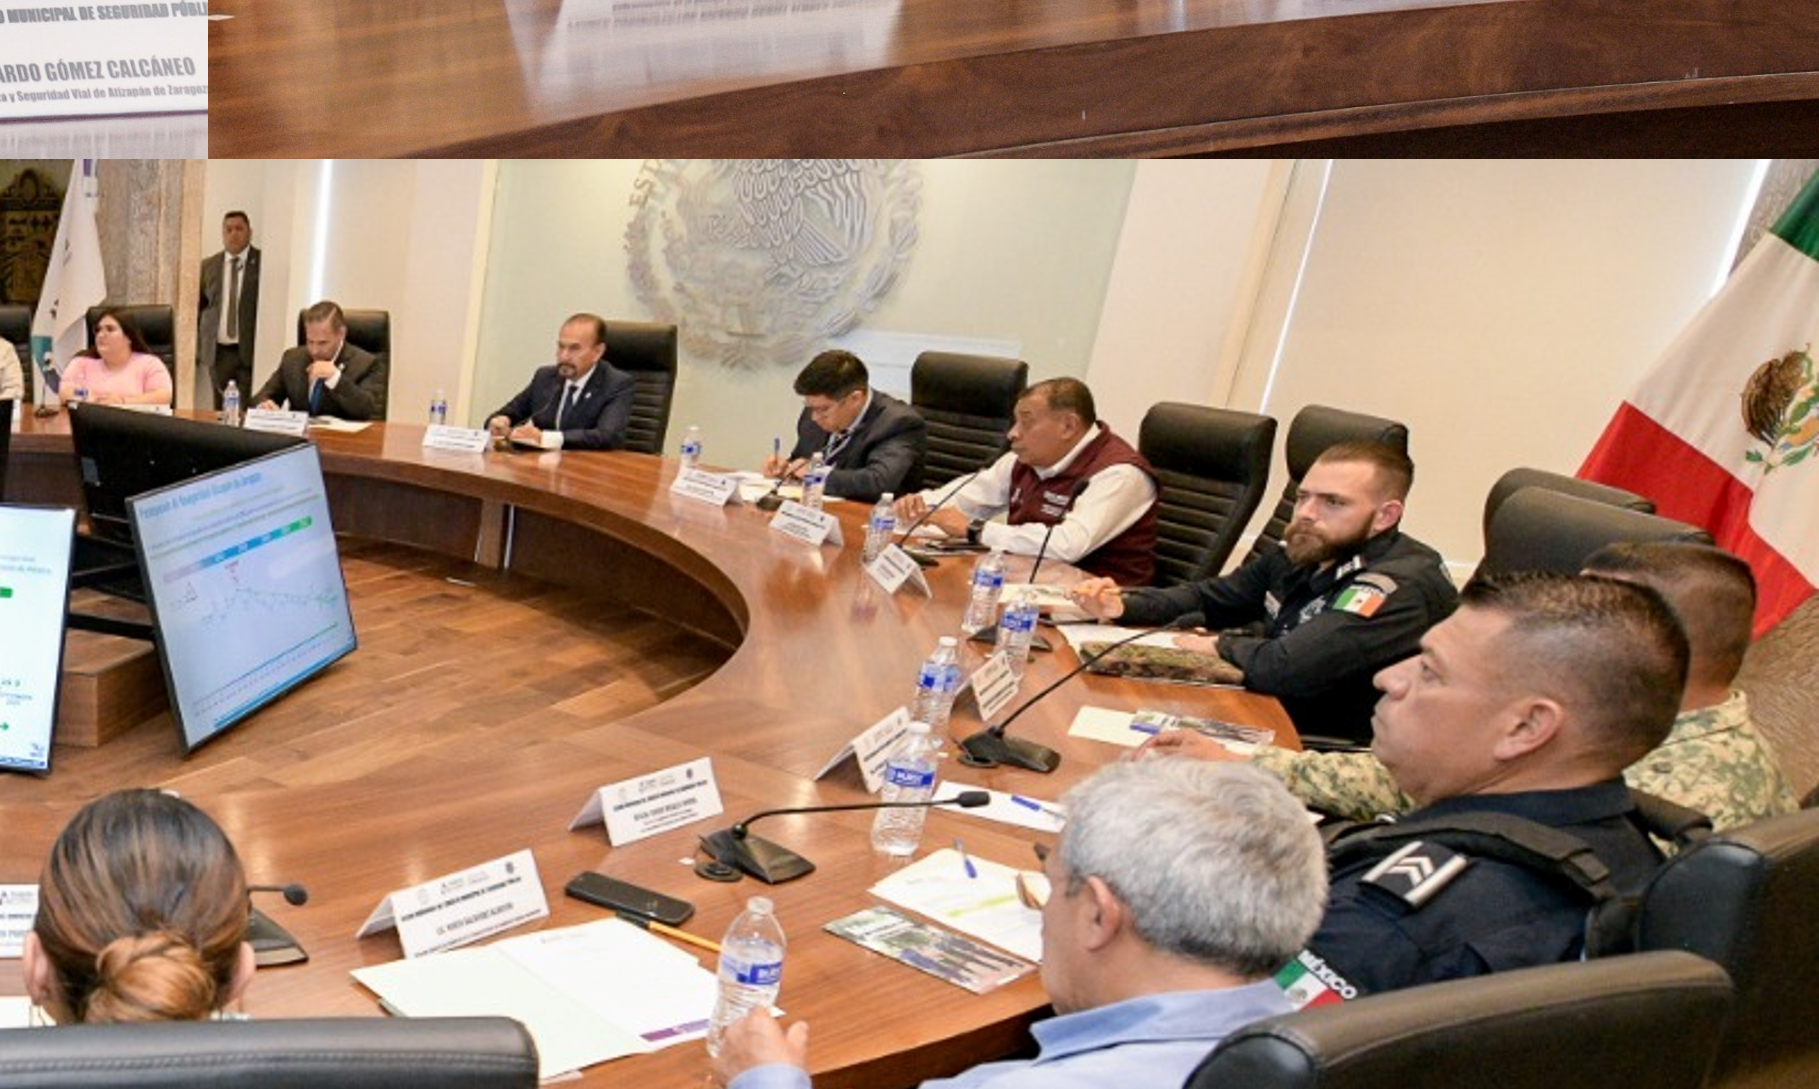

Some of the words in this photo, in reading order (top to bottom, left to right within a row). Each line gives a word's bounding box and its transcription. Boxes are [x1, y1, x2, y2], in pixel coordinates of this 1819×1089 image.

[7, 6, 77, 23] MUNICIPAL
[78, 6, 96, 20] DE
[97, 2, 169, 20] SEGURIDAD
[170, 0, 208, 17] PÚBLI
[44, 58, 105, 82] GÓMEZ
[107, 55, 196, 79] CALCÁNEO
[18, 88, 70, 102] Seguridad
[72, 86, 91, 99] Vial
[93, 87, 106, 98] de
[108, 84, 152, 99] Atizapán
[153, 85, 166, 96] de
[167, 84, 208, 97] Zaragoz
